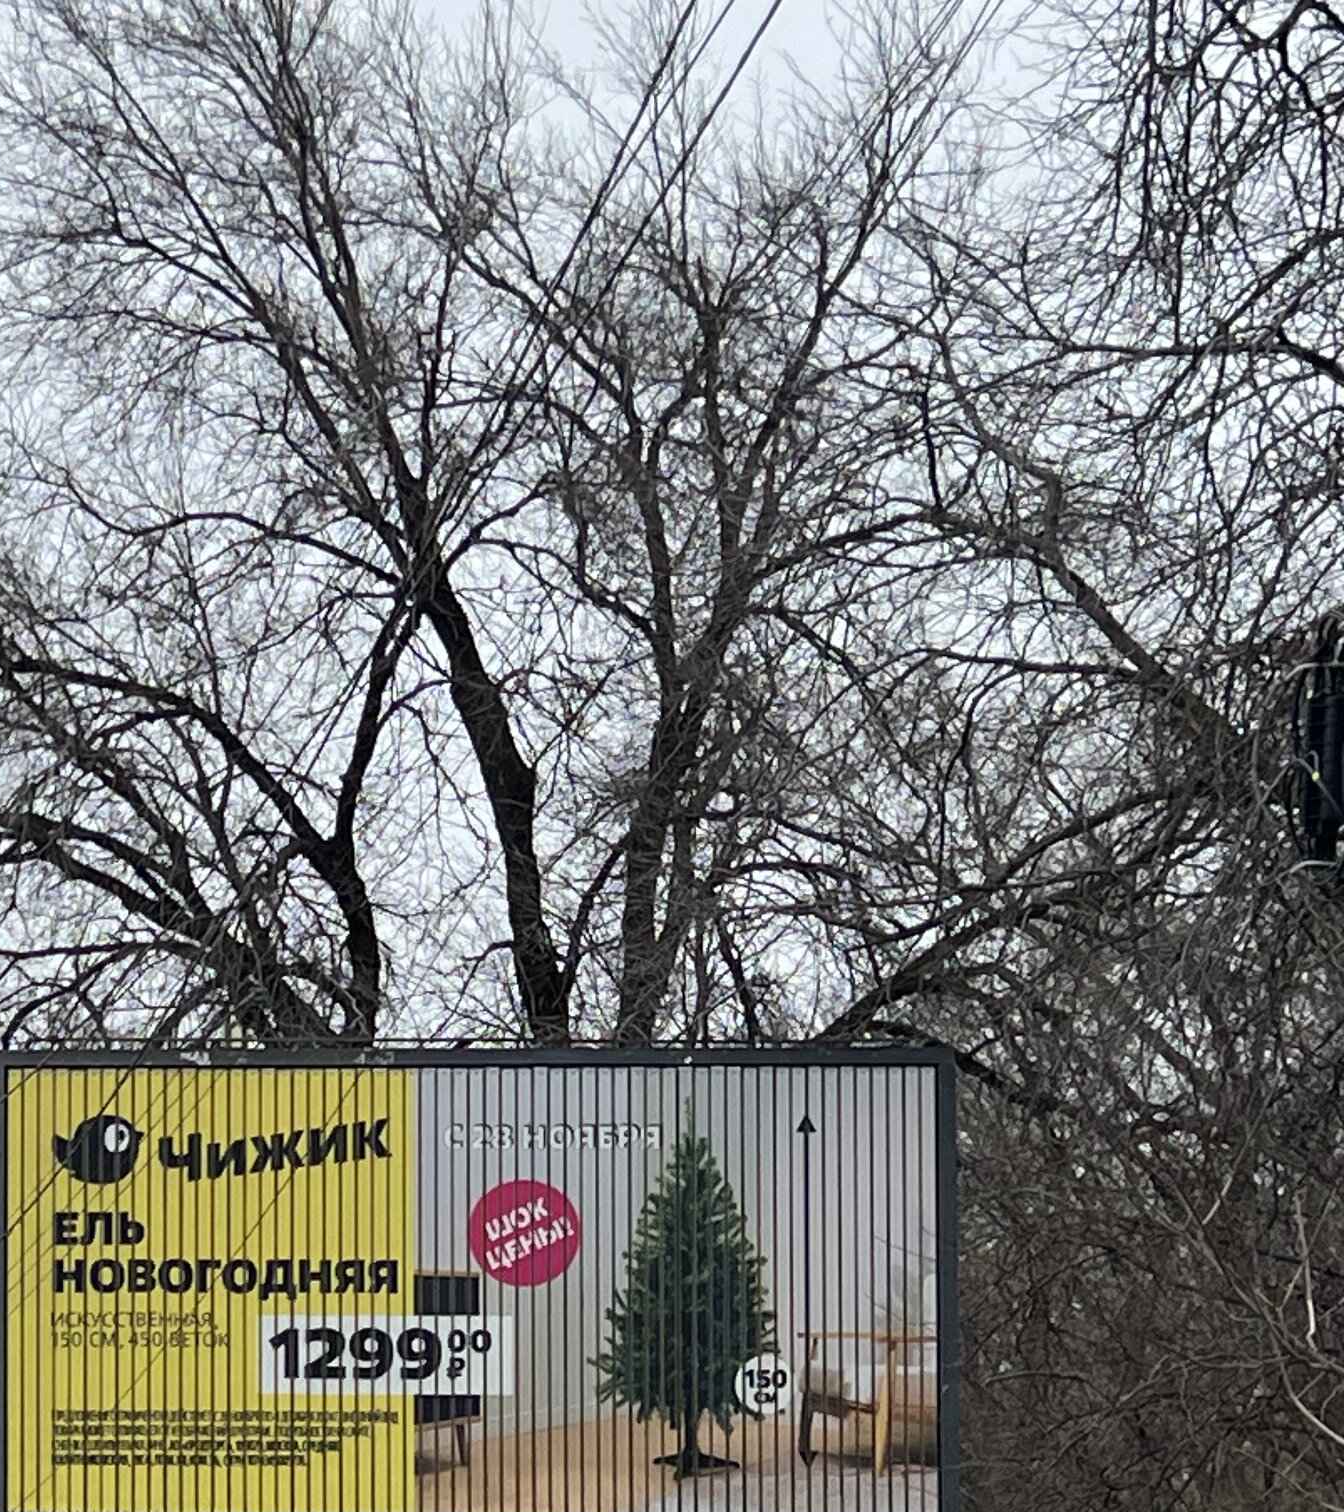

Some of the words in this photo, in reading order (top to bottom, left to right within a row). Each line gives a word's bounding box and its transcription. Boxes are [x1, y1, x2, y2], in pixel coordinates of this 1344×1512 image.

[522, 1123, 663, 1150] НОЯБРЯ
[53, 1211, 145, 1246] ЕЛЬ
[52, 1258, 399, 1301] НОВОГОДНЯЯ
[51, 1331, 82, 1349] 150
[269, 1327, 442, 1380] 1299
[743, 1369, 788, 1389] 150
